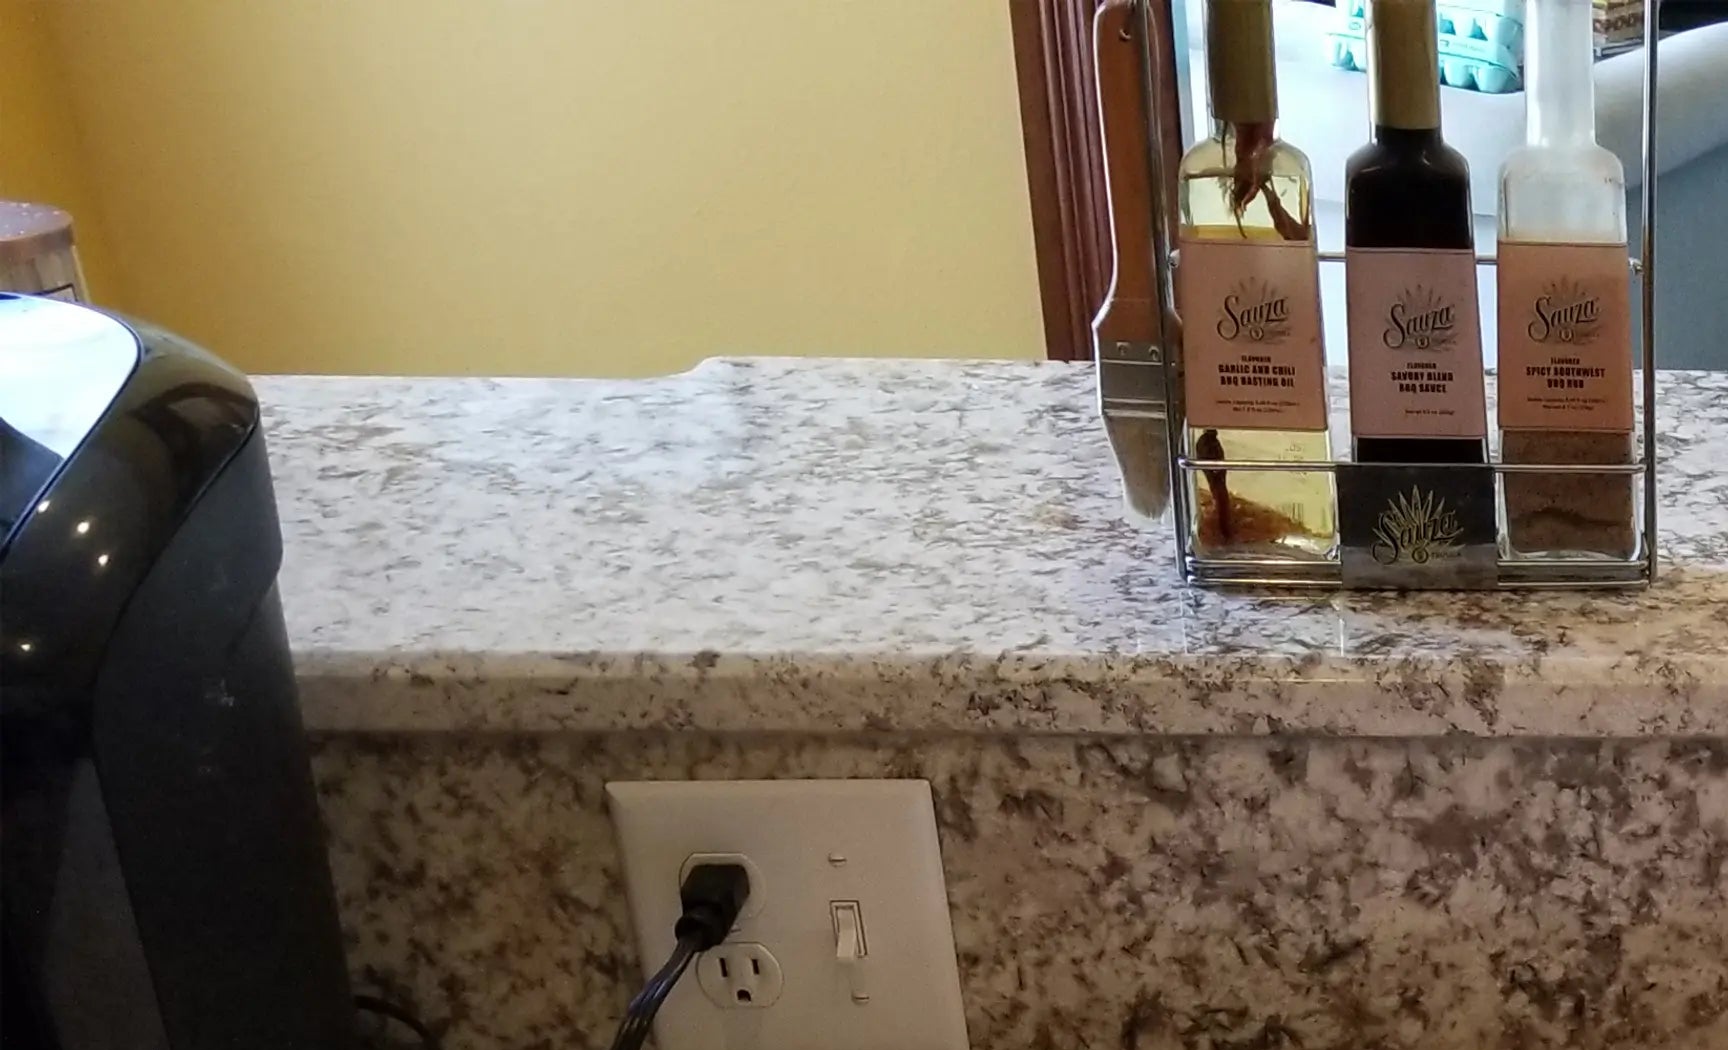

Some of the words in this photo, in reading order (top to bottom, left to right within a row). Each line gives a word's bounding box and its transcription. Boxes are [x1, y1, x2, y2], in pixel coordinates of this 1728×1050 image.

[1217, 295, 1290, 341] Sauza
[1528, 297, 1600, 342] Sauza
[1383, 303, 1455, 349] Sauza
[1218, 364, 1250, 374] GARLIC
[1252, 365, 1270, 374] AND
[1272, 366, 1296, 376] CHILI
[1391, 371, 1425, 381] SAVORY
[1526, 366, 1551, 376] SPICY
[1553, 367, 1606, 378] SOUTHWEST
[1220, 376, 1239, 387] BBQ
[1241, 376, 1279, 387] BASTING
[1281, 377, 1295, 388] OIL
[1399, 383, 1417, 394] BBQ
[1419, 383, 1447, 393] SAUCE
